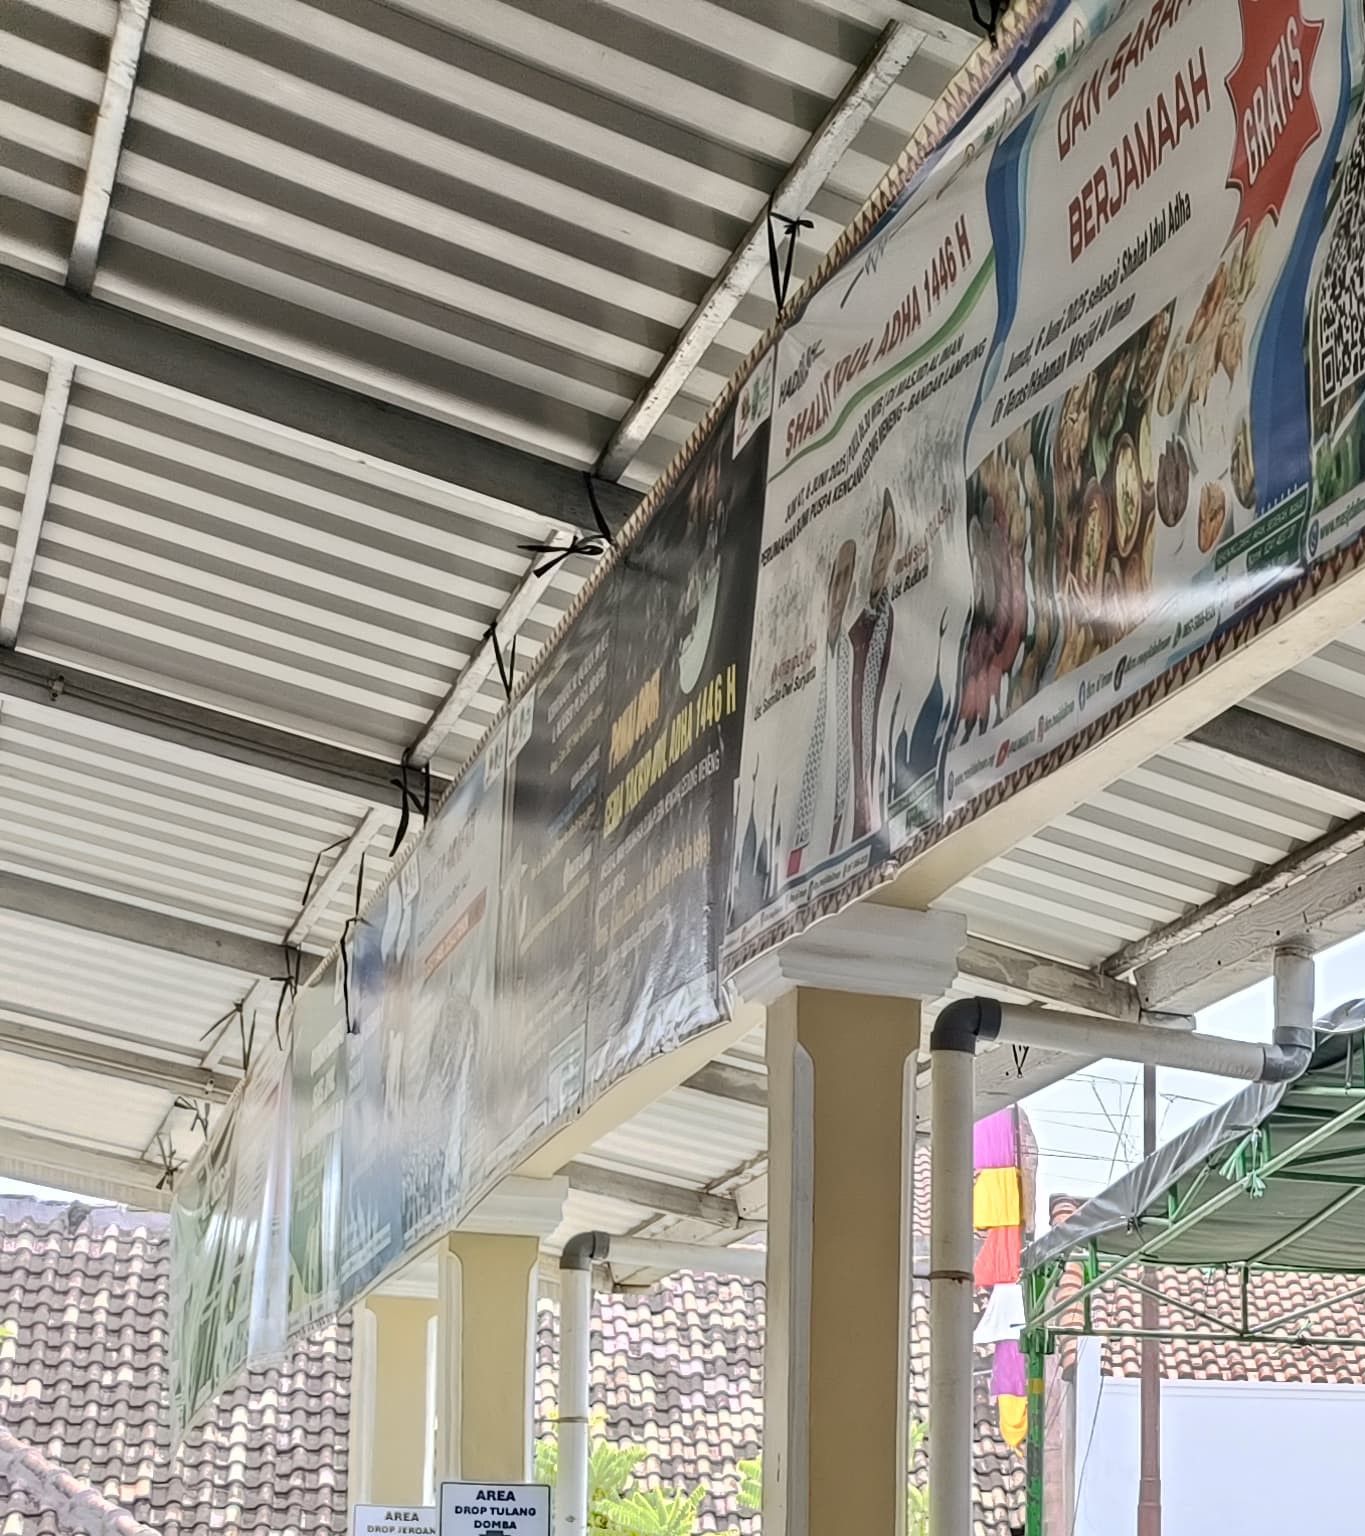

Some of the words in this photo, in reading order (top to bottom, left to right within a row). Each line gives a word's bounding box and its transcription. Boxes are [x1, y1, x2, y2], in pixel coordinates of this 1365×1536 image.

[1057, 59, 1109, 161] DAN
[1243, 16, 1303, 186] GRATIS
[1068, 46, 1211, 264] BERJAMAAH
[1061, 288, 1089, 334] 2025
[1120, 231, 1149, 284] Shalat
[1149, 209, 1167, 258] Idul
[1168, 192, 1192, 236] Adha
[785, 370, 832, 458] SHALAT
[832, 337, 875, 399] IDUL
[872, 285, 921, 363] ADHA
[924, 236, 958, 314] 1446
[954, 213, 972, 268] H
[668, 701, 693, 768] ADHA
[695, 673, 723, 739] 1446
[726, 663, 737, 715] H
[367, 1525, 395, 1534] DROP
[384, 1511, 420, 1523] AREA
[455, 1506, 487, 1515] DROP
[474, 1520, 517, 1530] DOMBA
[475, 1490, 516, 1502] AREA
